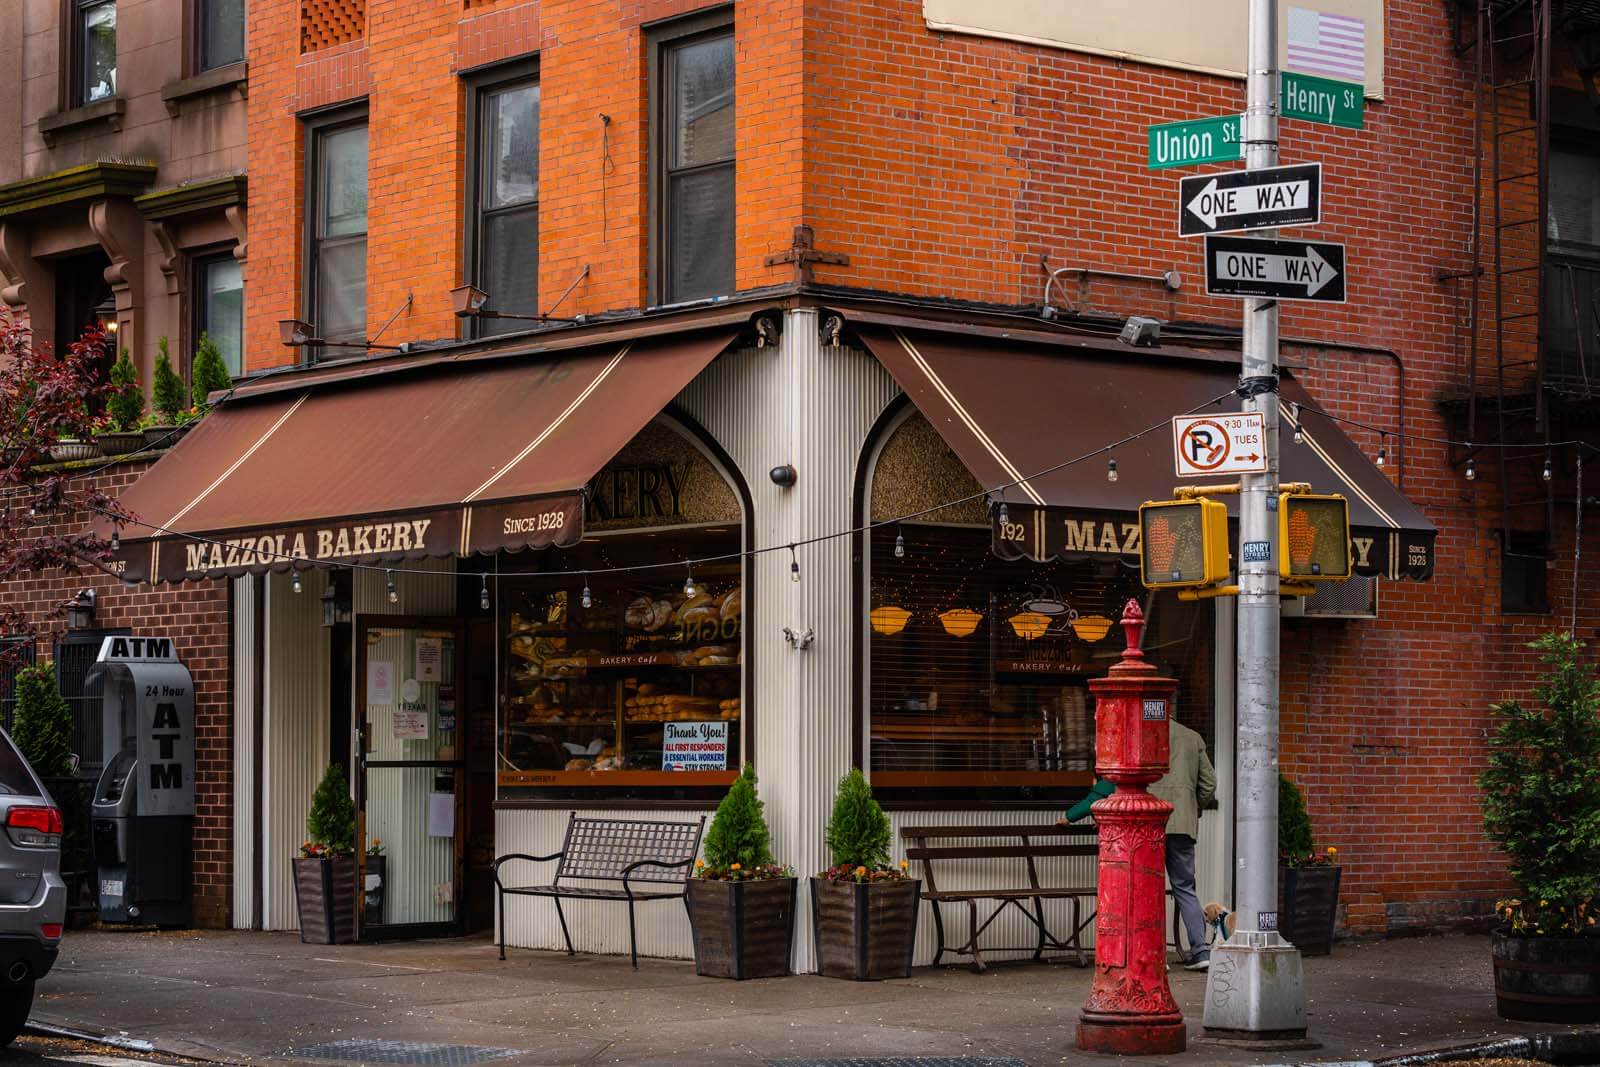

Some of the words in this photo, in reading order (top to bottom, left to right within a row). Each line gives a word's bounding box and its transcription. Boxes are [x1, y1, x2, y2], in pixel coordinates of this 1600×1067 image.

[1287, 80, 1336, 124] Henry
[1344, 90, 1354, 109] St
[1156, 127, 1213, 163] Union
[1223, 122, 1236, 143] St
[1200, 191, 1237, 216] ONE
[1256, 184, 1300, 210] WAY
[1227, 255, 1267, 279] ONE
[1285, 259, 1324, 283] WAY
[1234, 434, 1258, 445] TUES
[503, 517, 535, 535] SINCE
[537, 511, 565, 531] 1928
[1000, 522, 1025, 542] 192
[185, 532, 309, 572] MAZZOLA
[316, 518, 432, 560] BAKERY
[1064, 519, 1141, 554] MAZ
[1244, 542, 1270, 553] HENRY
[110, 638, 170, 658] ATM
[600, 656, 631, 665] BAKERY
[1012, 662, 1052, 671] BAKERY
[145, 686, 158, 697] 24
[162, 685, 184, 697] Hour
[1143, 700, 1164, 710] HENRY
[666, 724, 697, 738] Thank
[700, 723, 725, 742] You!
[665, 743, 674, 751] ALL
[674, 743, 689, 751] FIRST
[690, 743, 725, 751] RESPONDERS
[670, 753, 698, 762] ESSENTIAL
[698, 753, 725, 761] WORKERS
